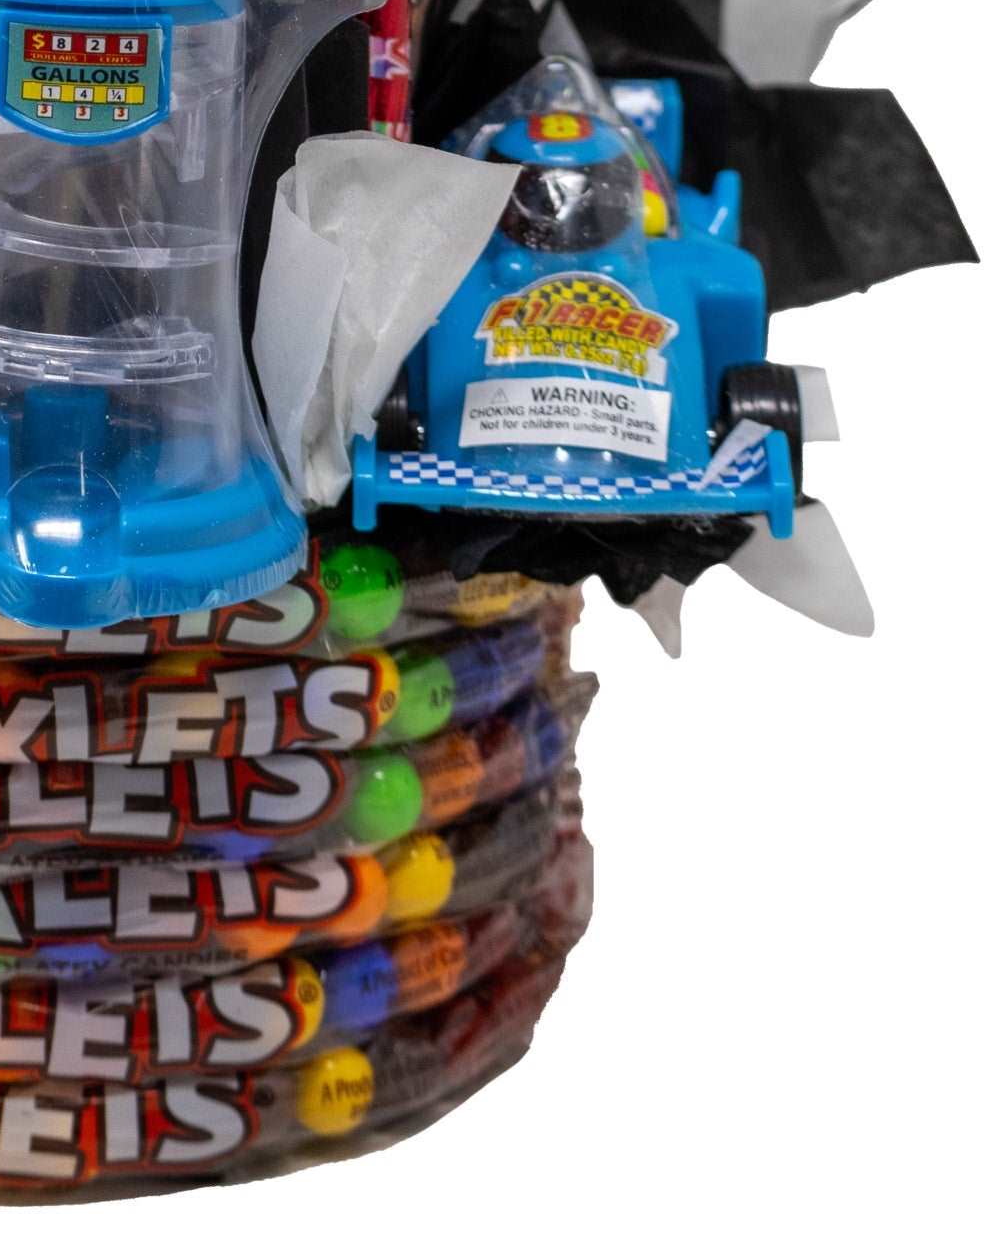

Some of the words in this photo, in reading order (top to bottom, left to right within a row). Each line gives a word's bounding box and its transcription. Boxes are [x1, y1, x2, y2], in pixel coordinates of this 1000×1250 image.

[56, 37, 67, 50] 8
[91, 39, 101, 52] 2
[123, 39, 134, 52] 4
[30, 66, 140, 85] GALLONS
[78, 88, 89, 99] 4
[548, 301, 666, 348] RACER
[550, 327, 593, 345] WITH
[594, 332, 649, 356] CANDY
[530, 386, 638, 413] WARNING:
[468, 404, 525, 420] CHOKING
[527, 405, 581, 418] HAZARD
[590, 407, 624, 424] Small
[625, 416, 659, 433] parts.
[479, 419, 499, 431] Not
[502, 417, 519, 430] for
[521, 417, 570, 431] children
[572, 420, 609, 435] under
[610, 426, 619, 436] 3
[620, 428, 656, 445] years.
